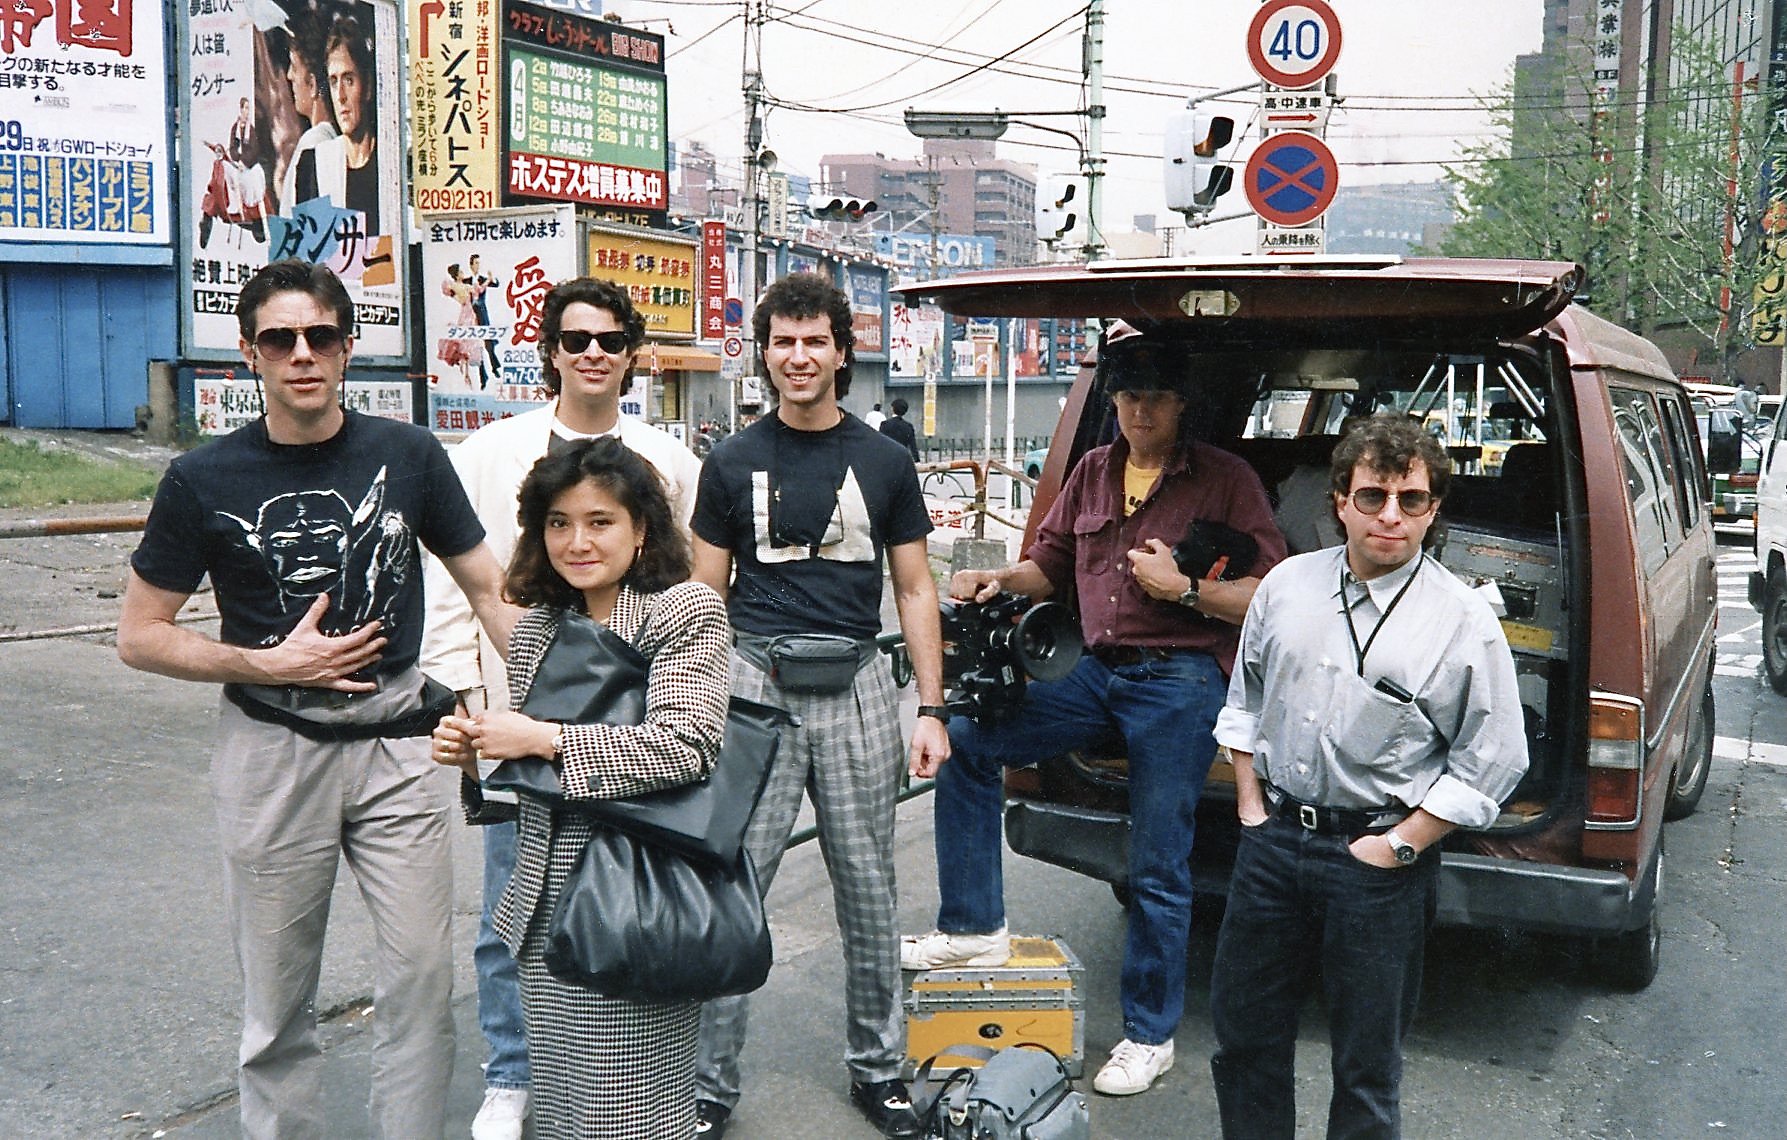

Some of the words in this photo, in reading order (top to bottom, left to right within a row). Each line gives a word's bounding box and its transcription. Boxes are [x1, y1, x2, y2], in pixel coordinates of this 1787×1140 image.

[1269, 20, 1320, 61] 40
[0, 57, 146, 79] グの新たなる才能を
[192, 72, 235, 96] ダンサー
[440, 43, 473, 188] シネパトス
[417, 188, 493, 211] (209)2131
[511, 155, 661, 205] ホステス増員募集中
[274, 213, 391, 274] ダンサー
[431, 219, 566, 243] 全て1万円で楽しめます。
[506, 256, 553, 346] 愛
[708, 255, 723, 331] 丸三商会
[448, 326, 508, 339] ダンスクラブ
